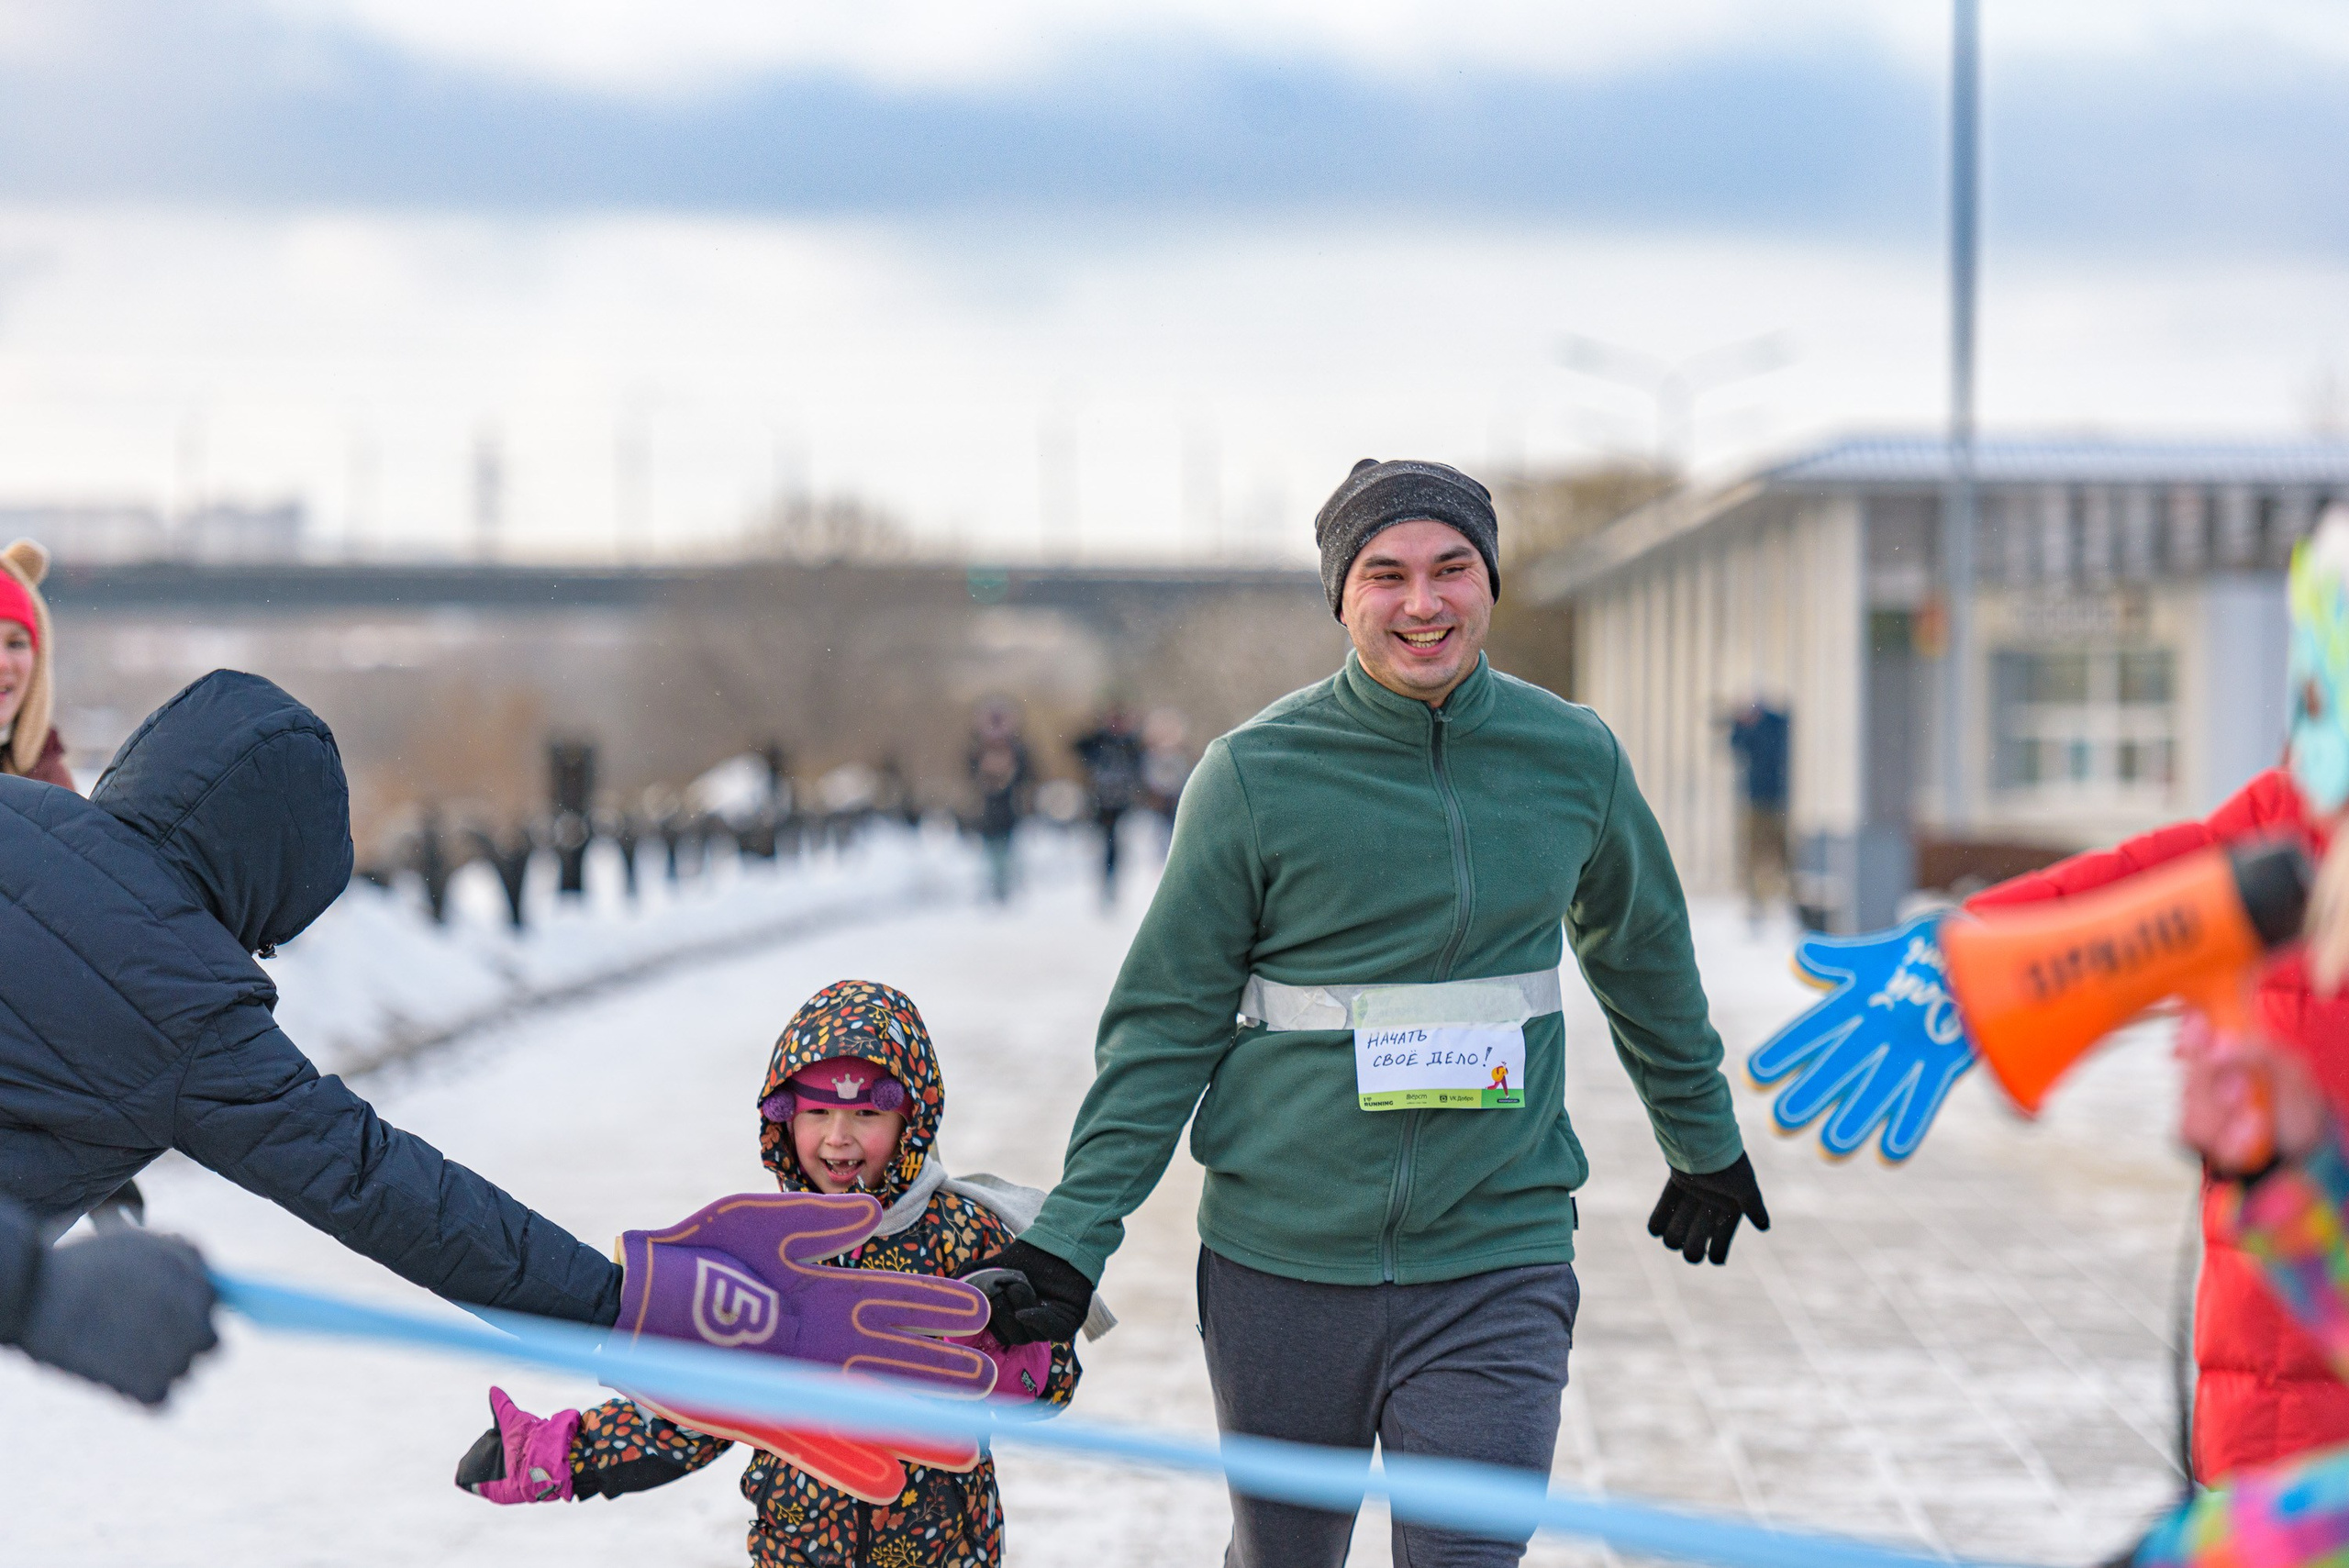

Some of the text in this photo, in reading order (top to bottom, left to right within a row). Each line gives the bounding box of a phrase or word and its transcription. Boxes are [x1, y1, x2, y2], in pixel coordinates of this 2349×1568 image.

[1367, 1029, 1428, 1049] НАЧАТЬ
[1373, 1047, 1493, 1067] СВОЁ ДЕЛО!
